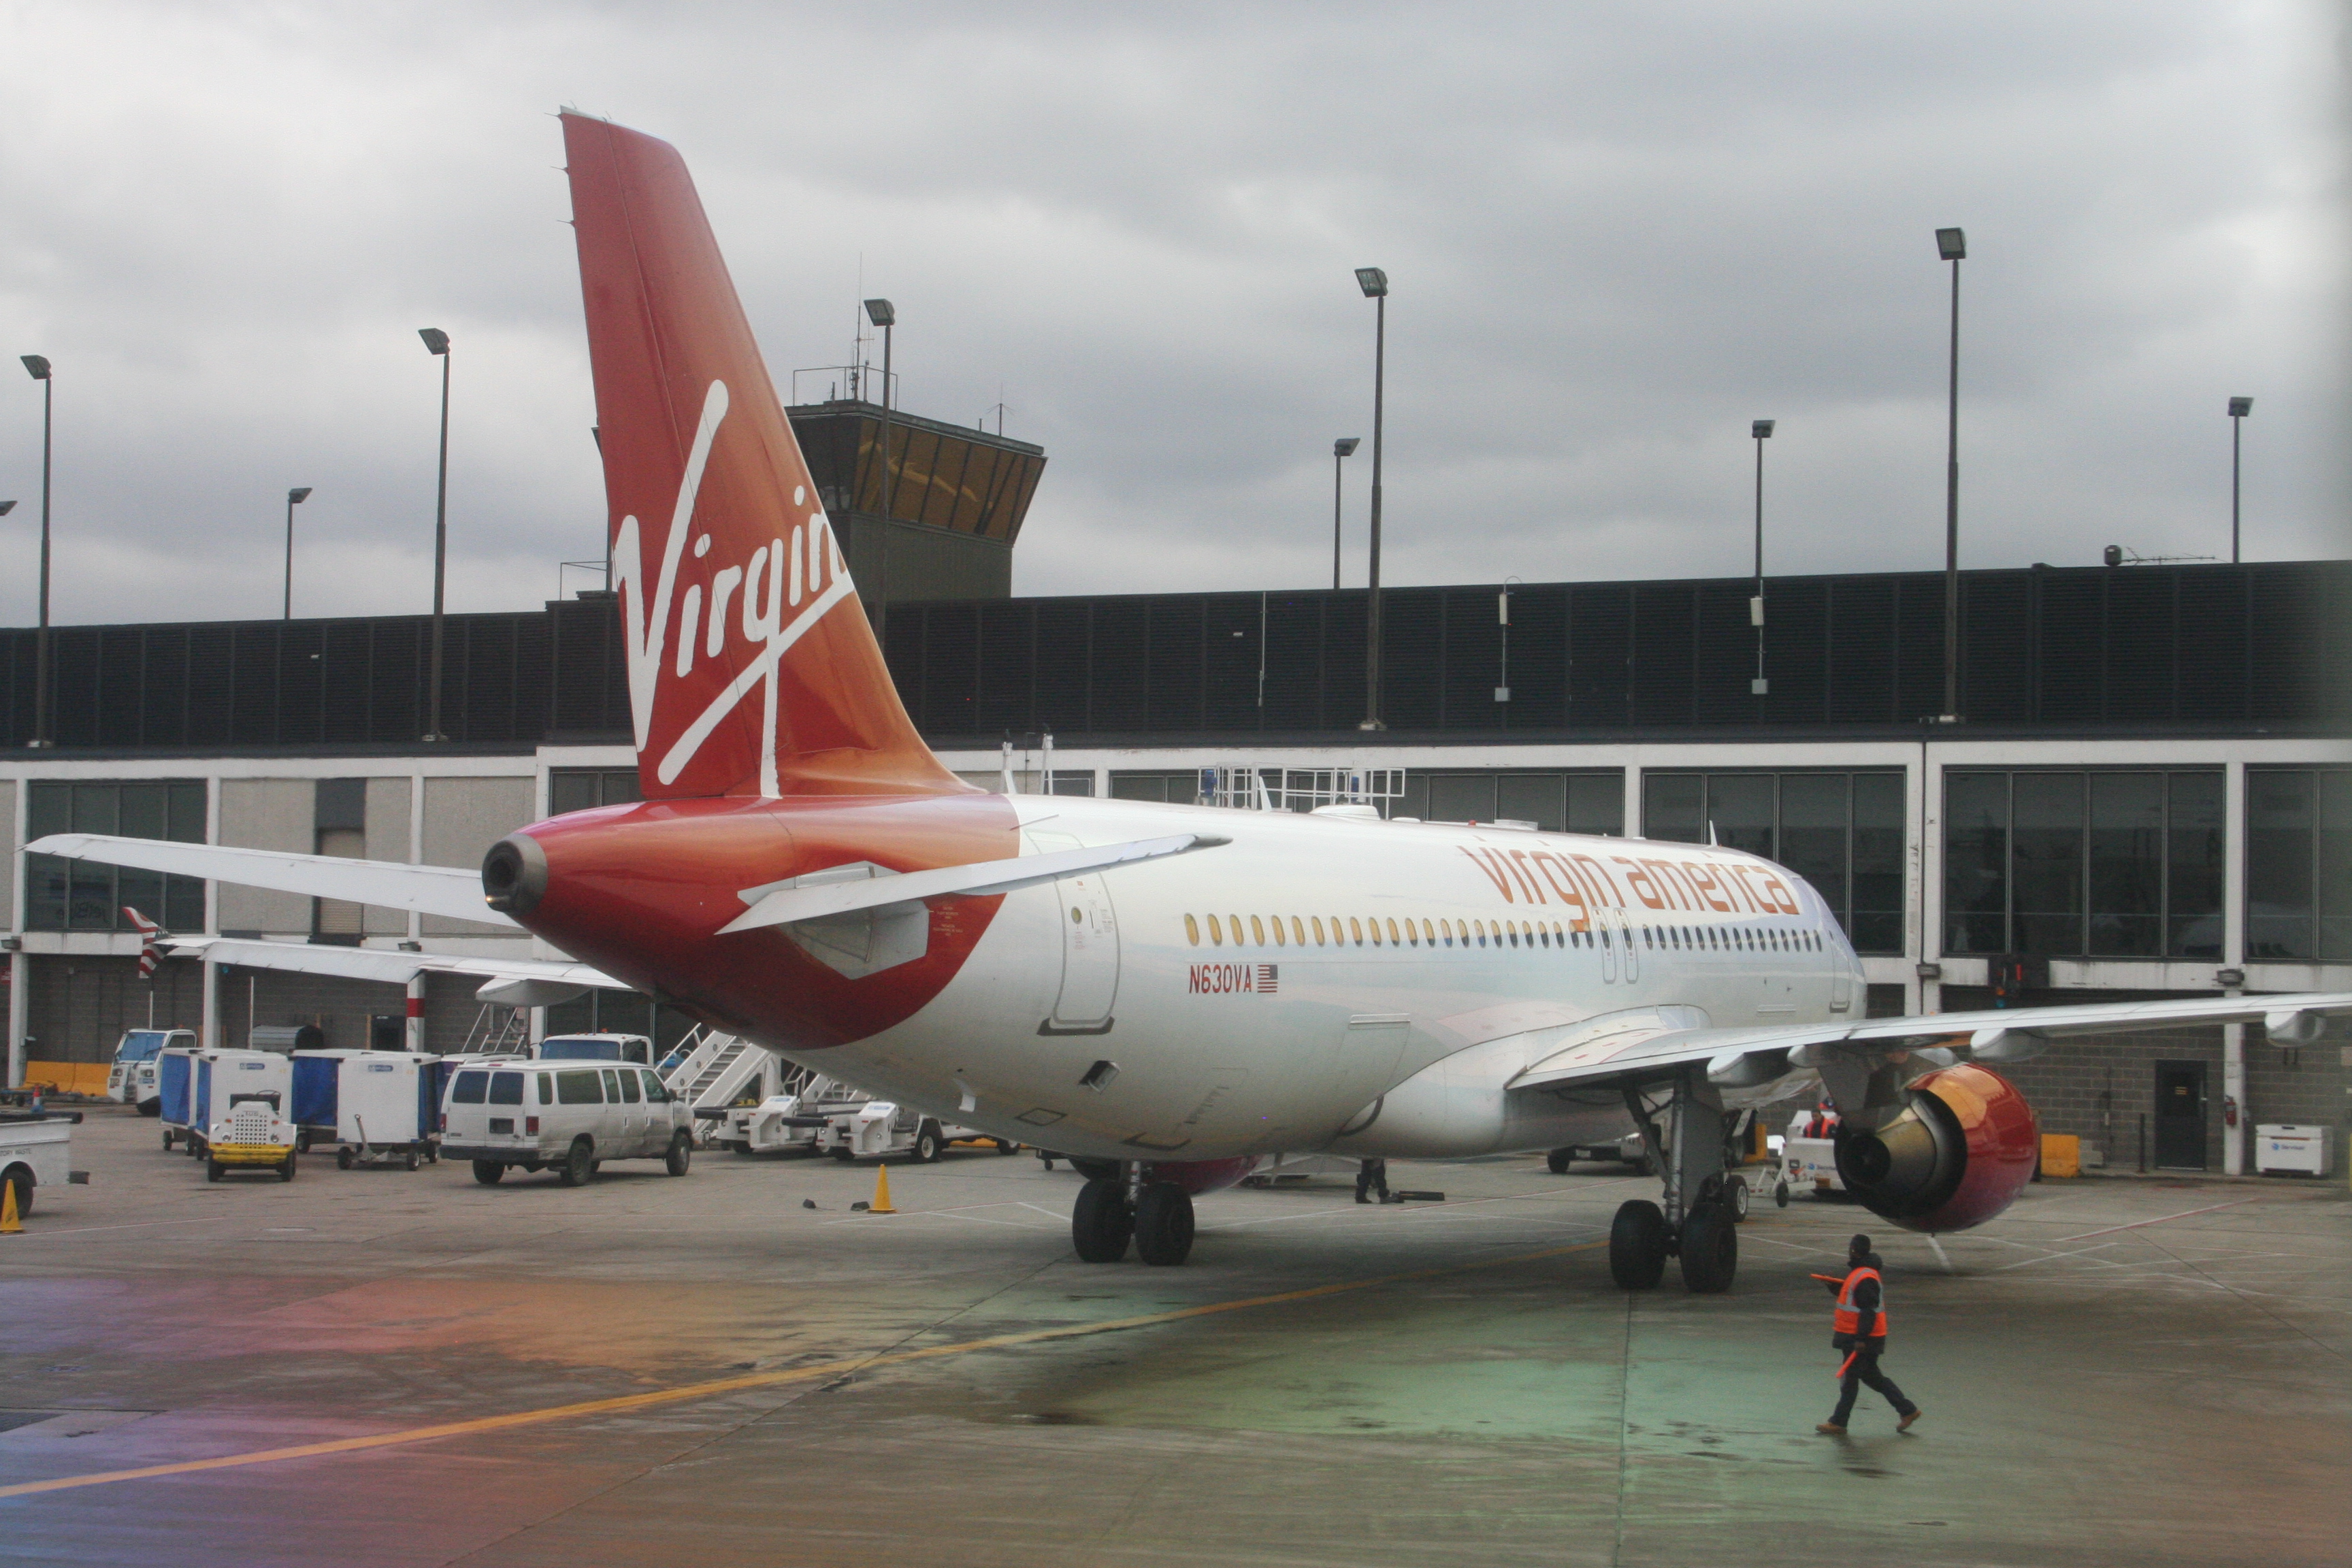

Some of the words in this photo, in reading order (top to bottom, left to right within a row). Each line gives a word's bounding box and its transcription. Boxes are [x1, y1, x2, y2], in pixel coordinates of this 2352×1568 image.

[613, 379, 854, 798] Virgin
[1456, 835, 1626, 933] virgin
[1610, 852, 1800, 915] america
[1189, 964, 1252, 994] N630VA
